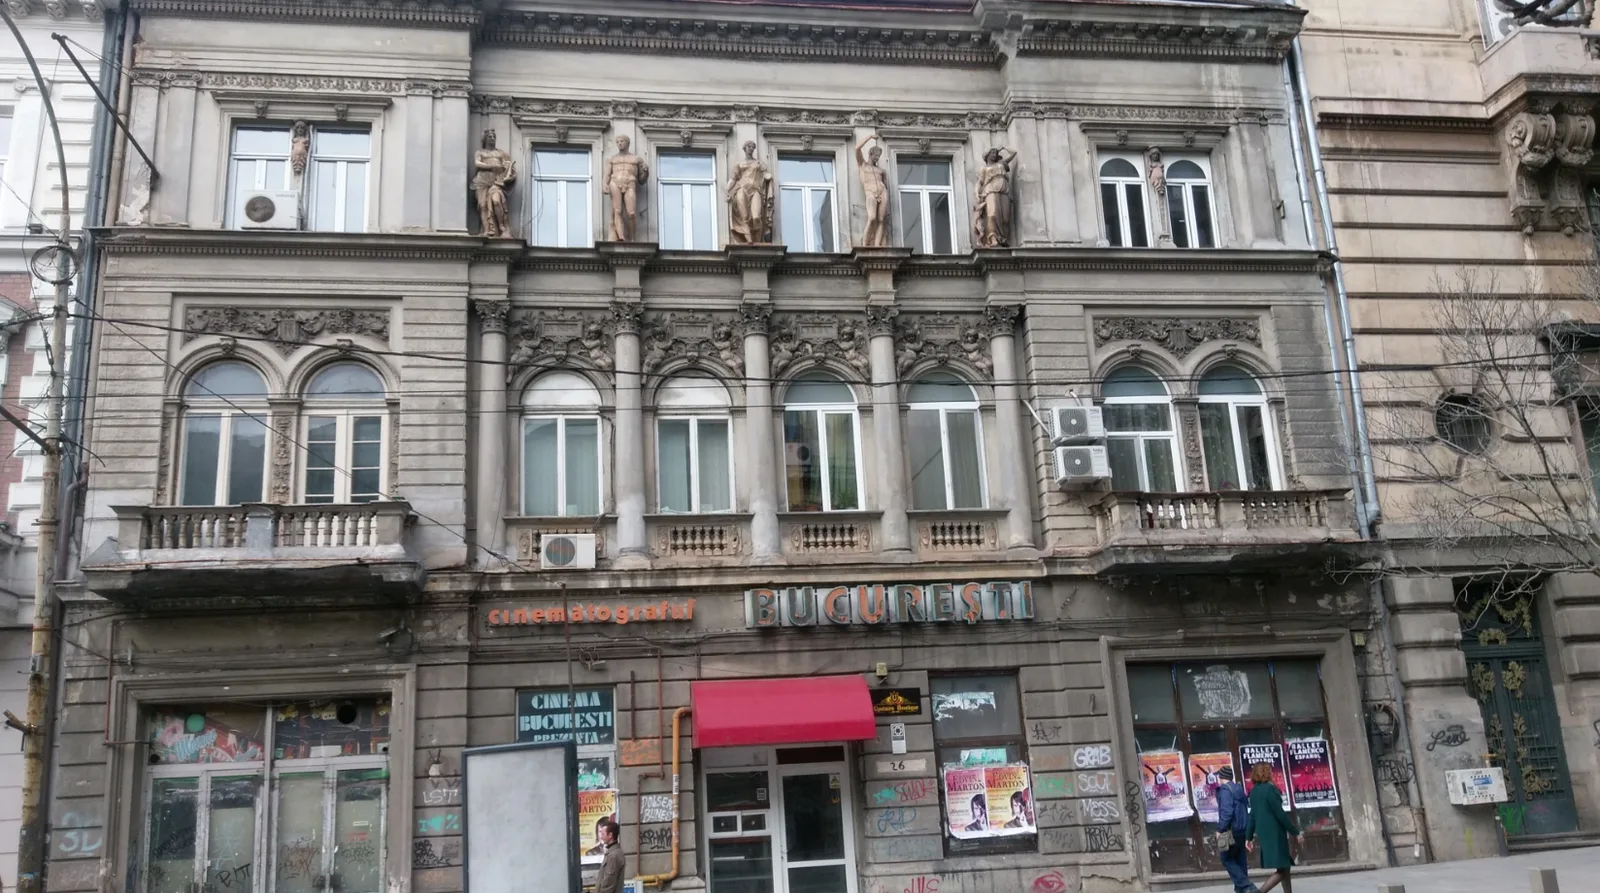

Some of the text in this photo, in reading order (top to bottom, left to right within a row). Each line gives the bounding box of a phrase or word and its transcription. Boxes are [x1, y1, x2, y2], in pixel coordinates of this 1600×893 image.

[487, 598, 697, 625] cinematograful
[531, 691, 601, 710] CINEMA
[519, 711, 612, 732] BUCURESTI
[1244, 746, 1275, 754] BALLET
[1291, 742, 1321, 750] BALLET
[1242, 751, 1279, 760] FLAMENCO
[1289, 747, 1325, 756] FLAMENCO
[890, 761, 906, 771] 26
[947, 783, 985, 792] MARTON
[986, 780, 1025, 789] MARTON
